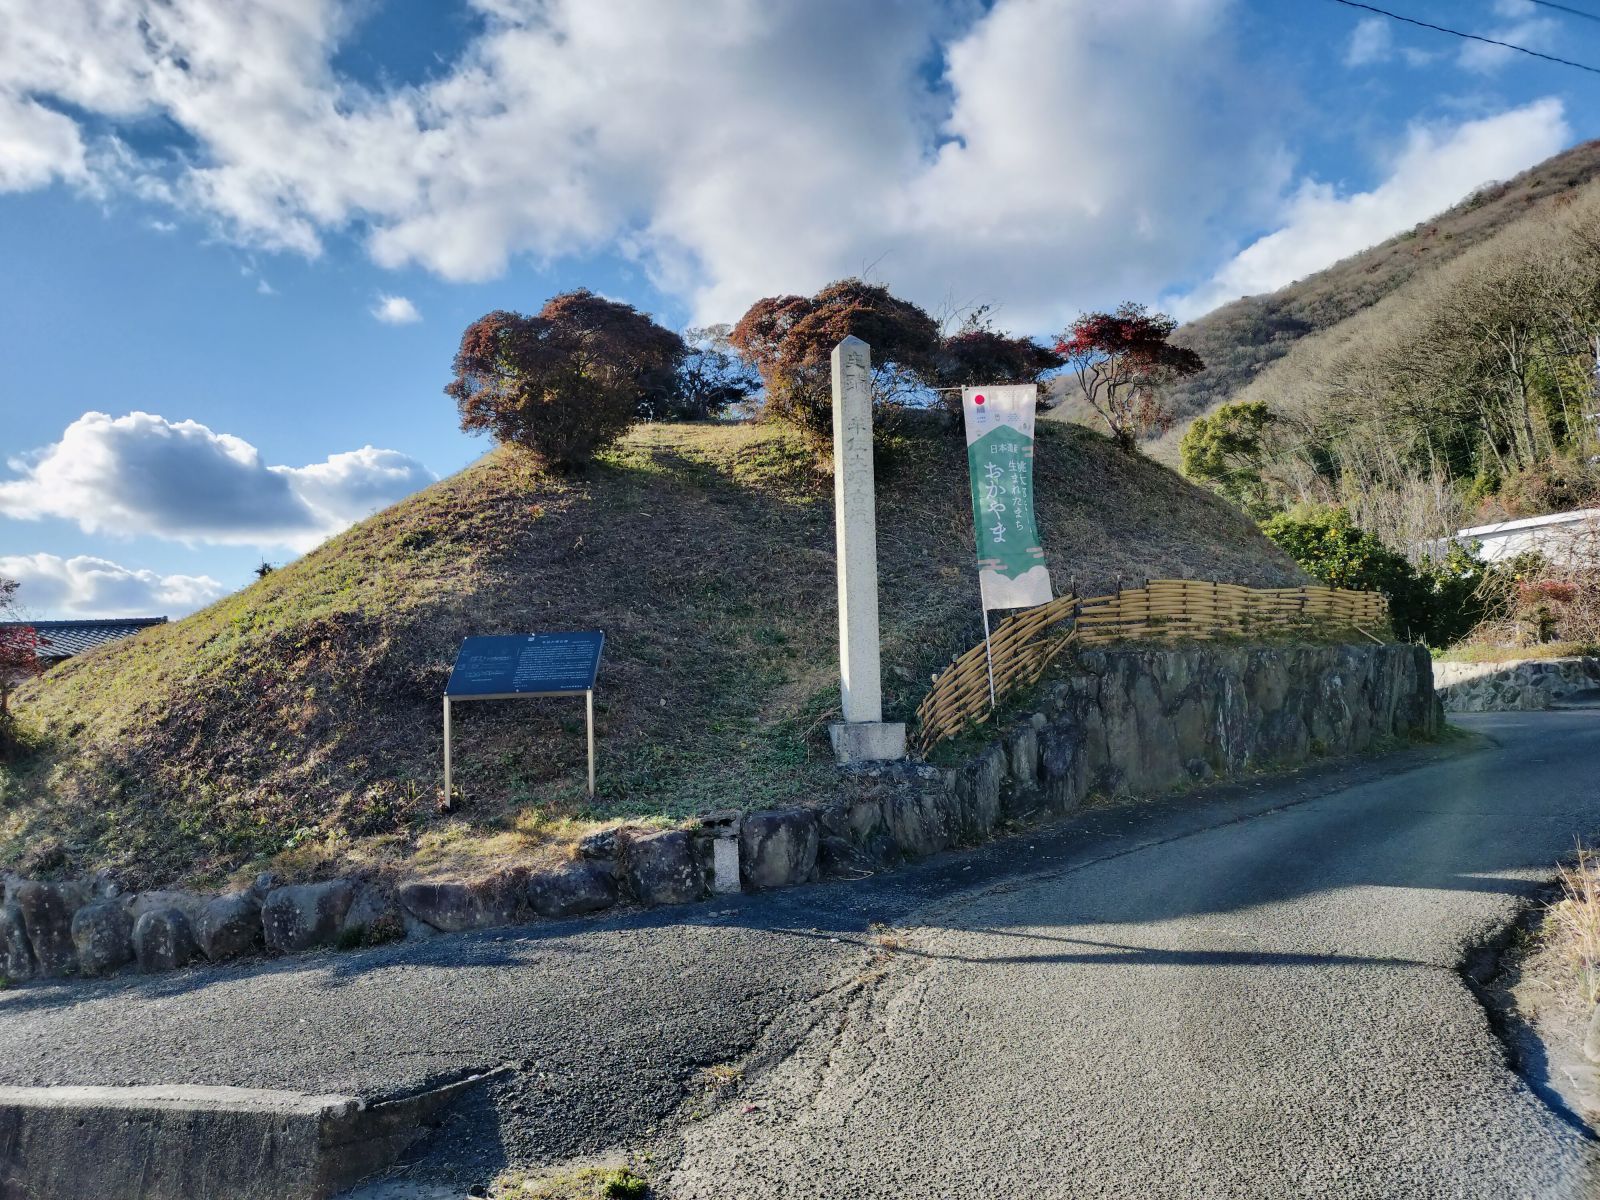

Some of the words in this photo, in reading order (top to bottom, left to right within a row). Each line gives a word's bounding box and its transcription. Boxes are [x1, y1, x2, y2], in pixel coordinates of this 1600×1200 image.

[984, 462, 1006, 543] おかやま
[1008, 460, 1024, 530] 生まれたまち
